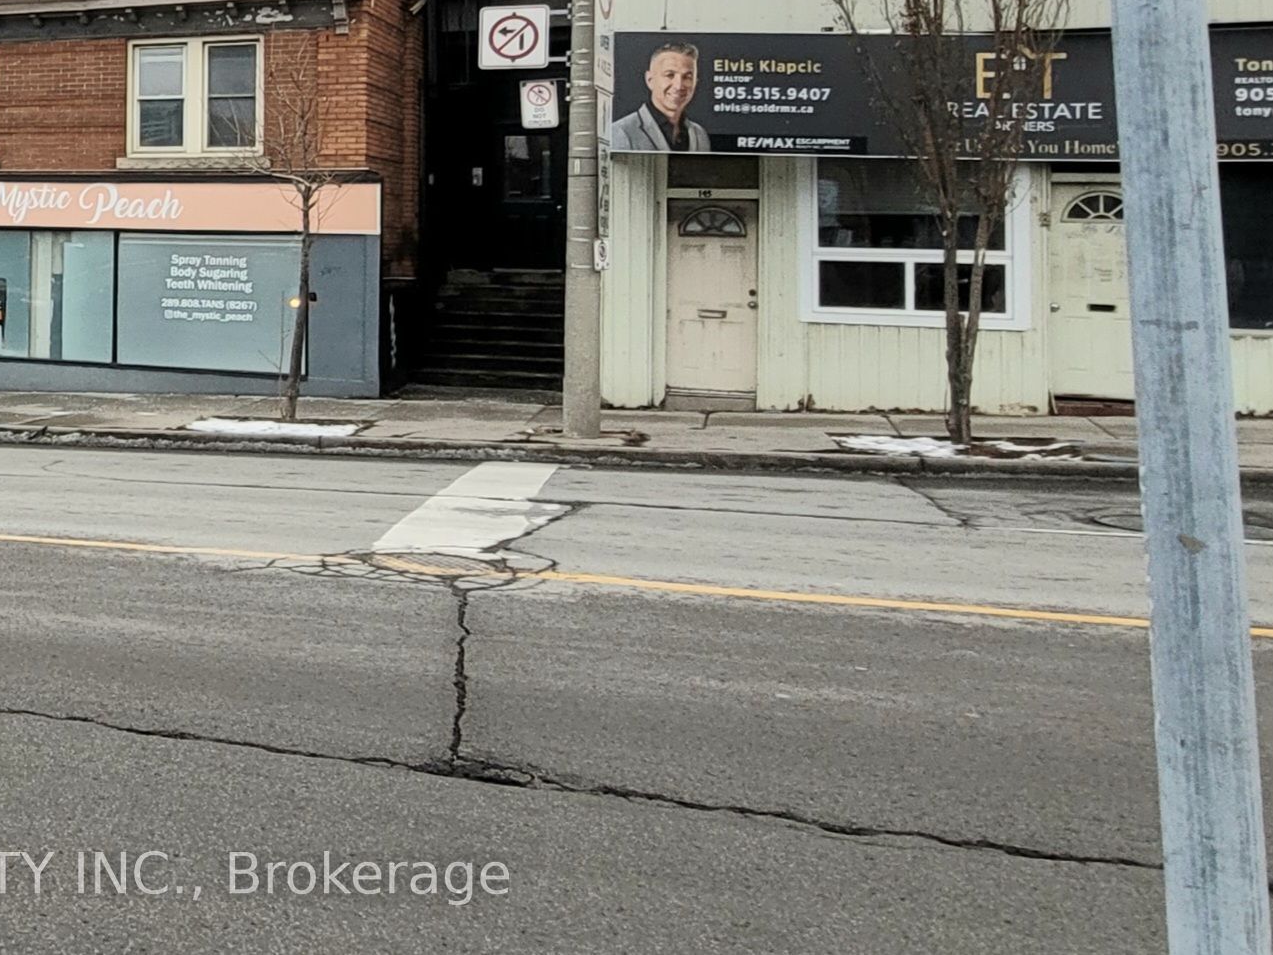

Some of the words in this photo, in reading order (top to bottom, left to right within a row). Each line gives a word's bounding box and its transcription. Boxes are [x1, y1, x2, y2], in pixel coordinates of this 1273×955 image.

[713, 59, 754, 73] Elvis
[759, 60, 822, 75] Klapcic
[713, 86, 831, 101] 905.515.9407
[713, 103, 814, 114] elvis@soldrmx.ca
[1011, 102, 1103, 120] ESTATE
[737, 137, 794, 149] RE/MAX
[1027, 140, 1059, 155] You
[79, 182, 184, 224] Peach
[171, 254, 202, 267] Spray
[203, 255, 248, 268] Tanning
[170, 266, 197, 279] Body
[199, 267, 248, 281] Sugaring
[165, 278, 195, 289] Teeth
[197, 280, 253, 293] Whitening
